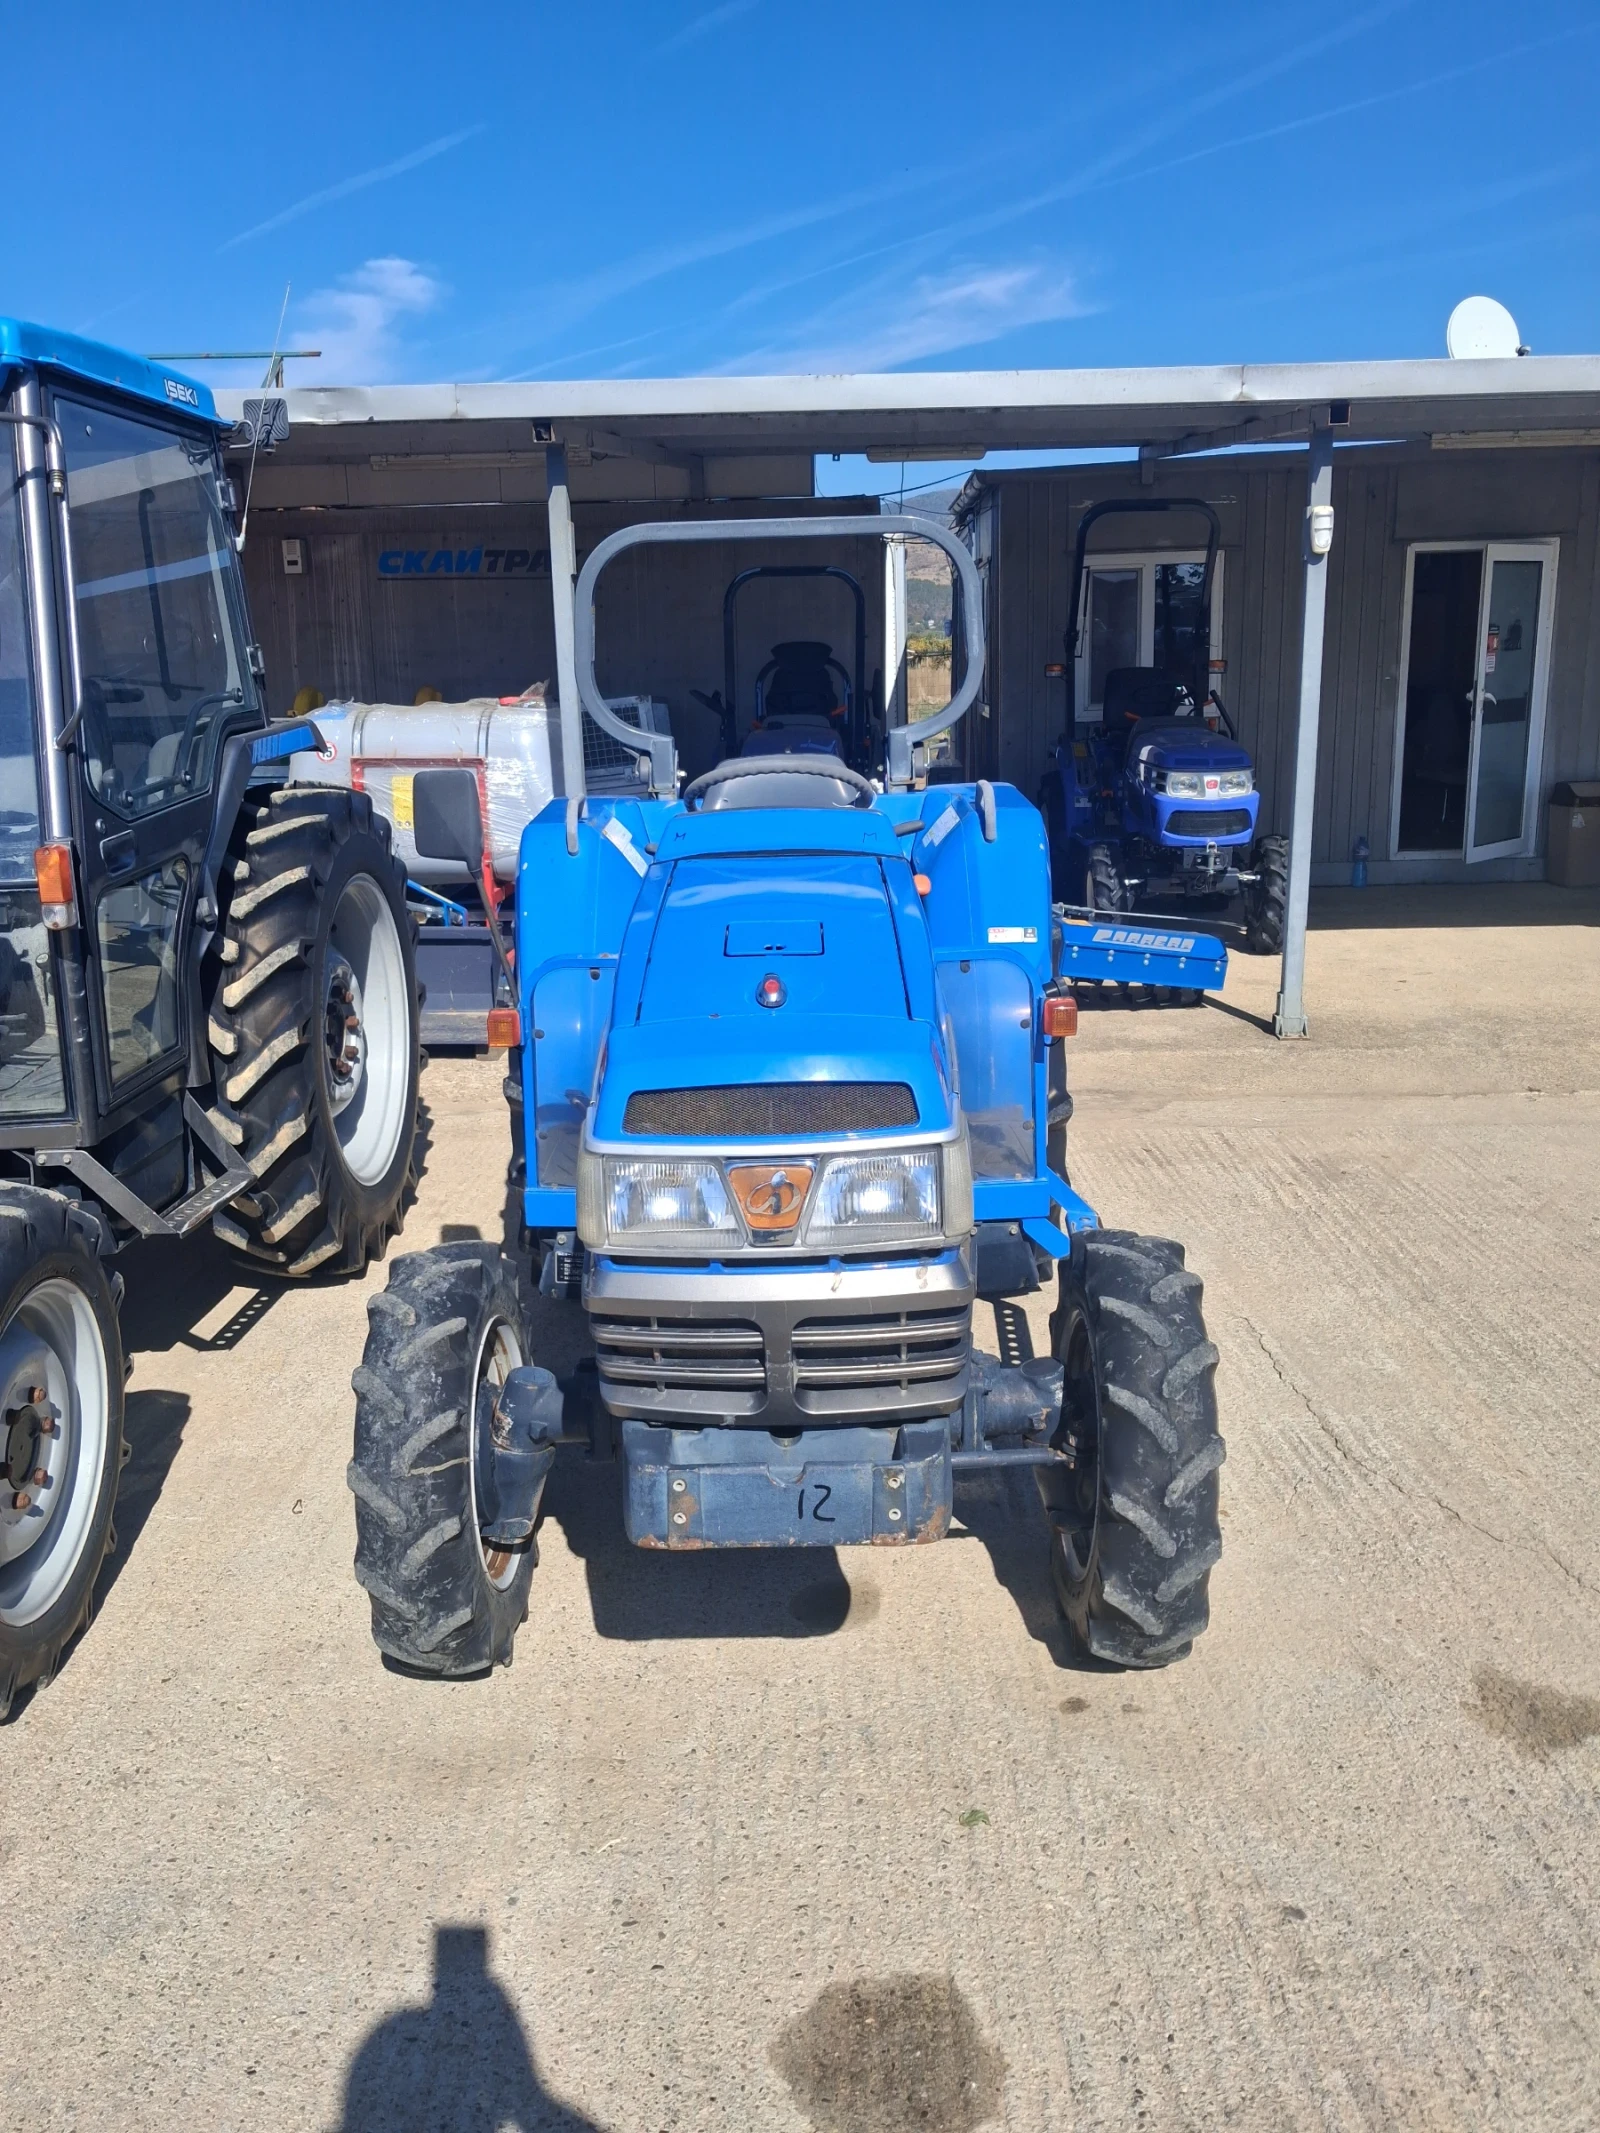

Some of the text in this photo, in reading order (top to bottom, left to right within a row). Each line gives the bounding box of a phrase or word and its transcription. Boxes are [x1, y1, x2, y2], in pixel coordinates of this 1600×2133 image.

[163, 378, 199, 406] ISEKI
[377, 545, 597, 575] СКАЙТРА
[797, 1484, 836, 1522] 12
